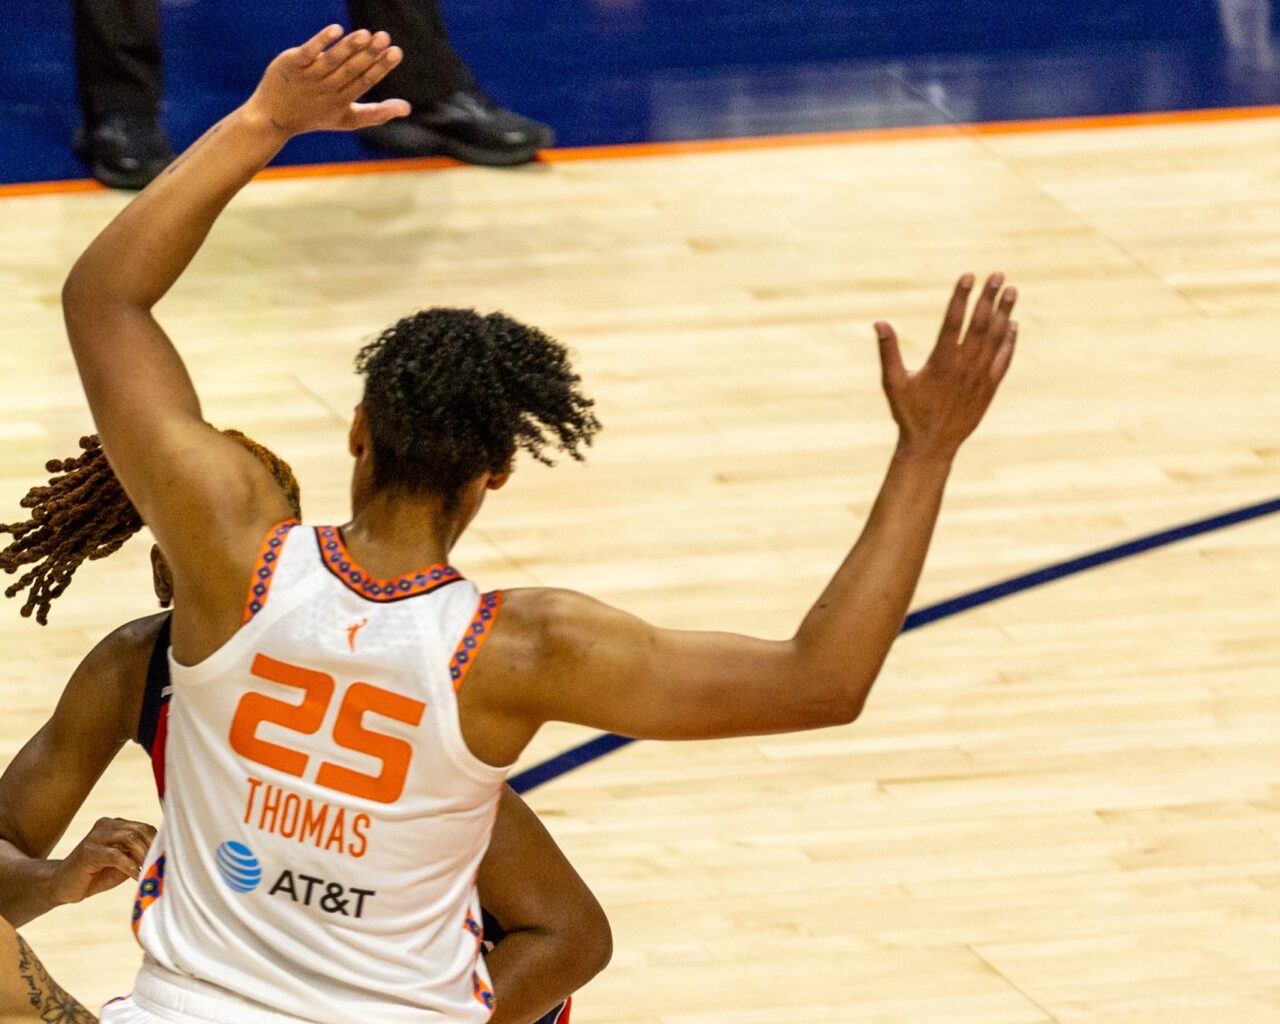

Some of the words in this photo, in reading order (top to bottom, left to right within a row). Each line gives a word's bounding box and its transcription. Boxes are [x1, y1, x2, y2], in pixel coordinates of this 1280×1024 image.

[229, 652, 426, 804] 25
[243, 777, 370, 858] THOMAS
[268, 869, 375, 918] AT&T
